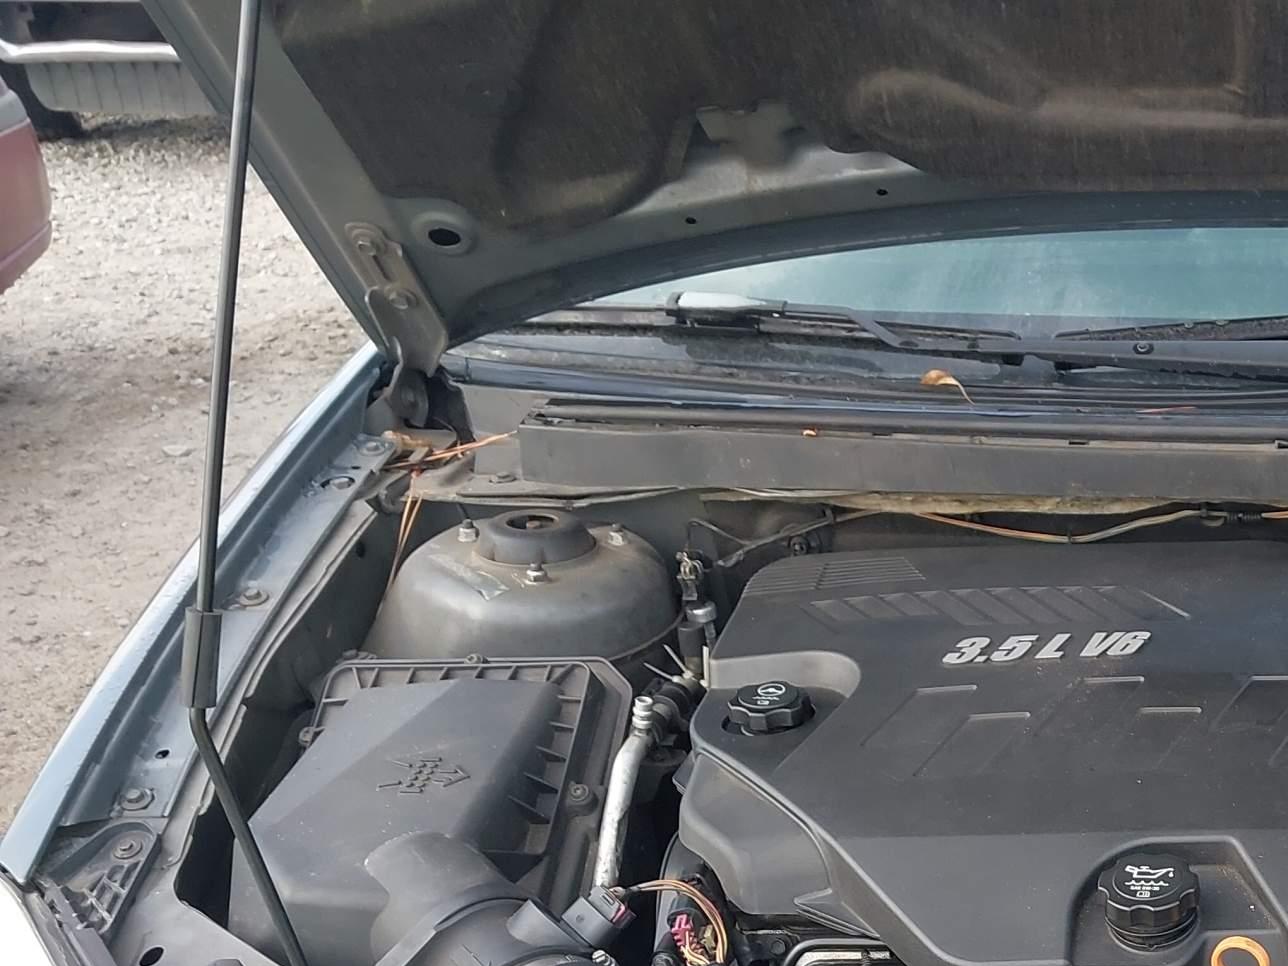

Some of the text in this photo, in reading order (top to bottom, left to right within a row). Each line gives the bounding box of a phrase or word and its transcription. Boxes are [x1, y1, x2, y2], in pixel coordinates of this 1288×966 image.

[942, 631, 1152, 664] 3.5 L V6
